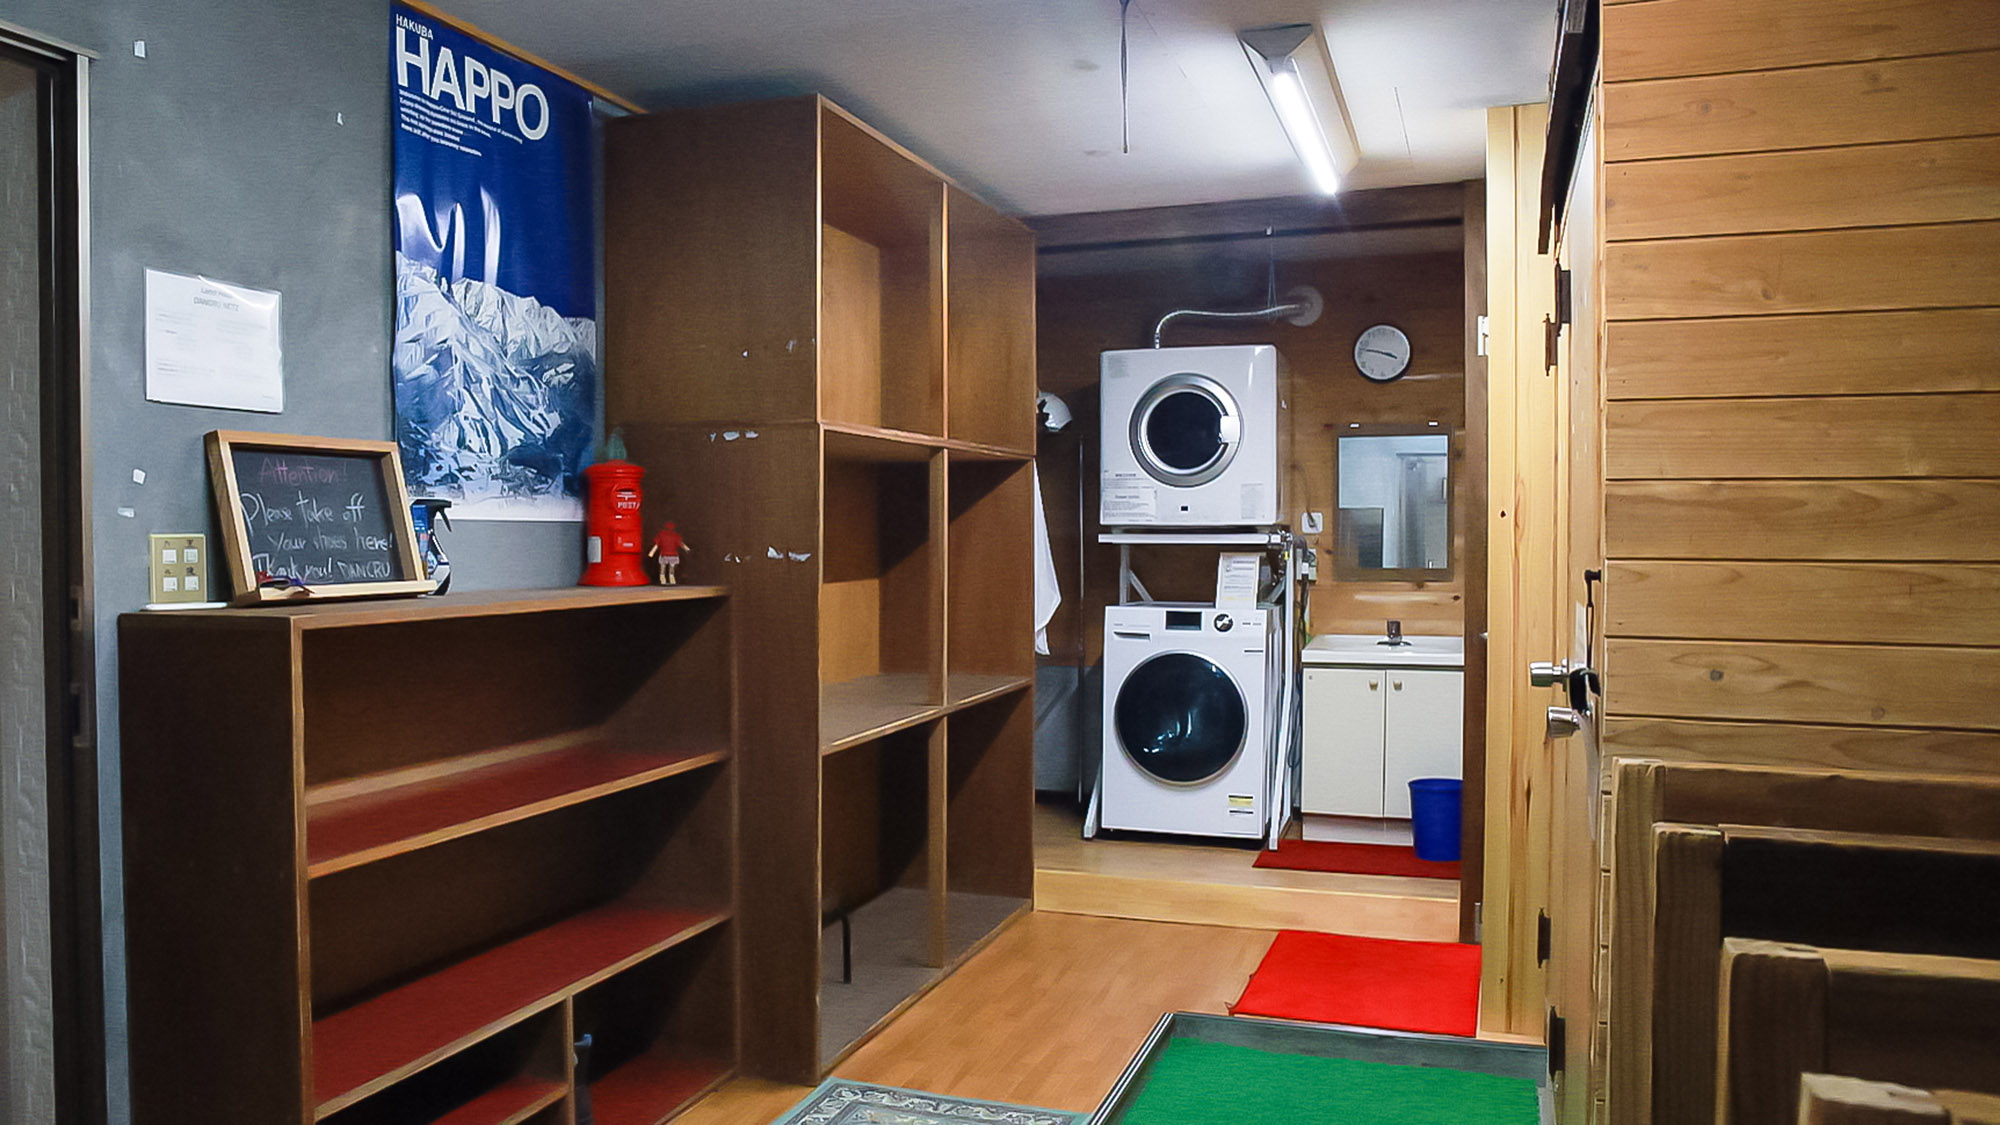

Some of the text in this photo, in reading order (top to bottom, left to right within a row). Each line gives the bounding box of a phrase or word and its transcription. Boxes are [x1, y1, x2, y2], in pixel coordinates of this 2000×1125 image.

[396, 14, 434, 40] HAKUBA
[396, 26, 550, 141] HAPPO
[240, 490, 365, 537] Please take off
[617, 501, 637, 510] POST
[353, 526, 393, 552] here!
